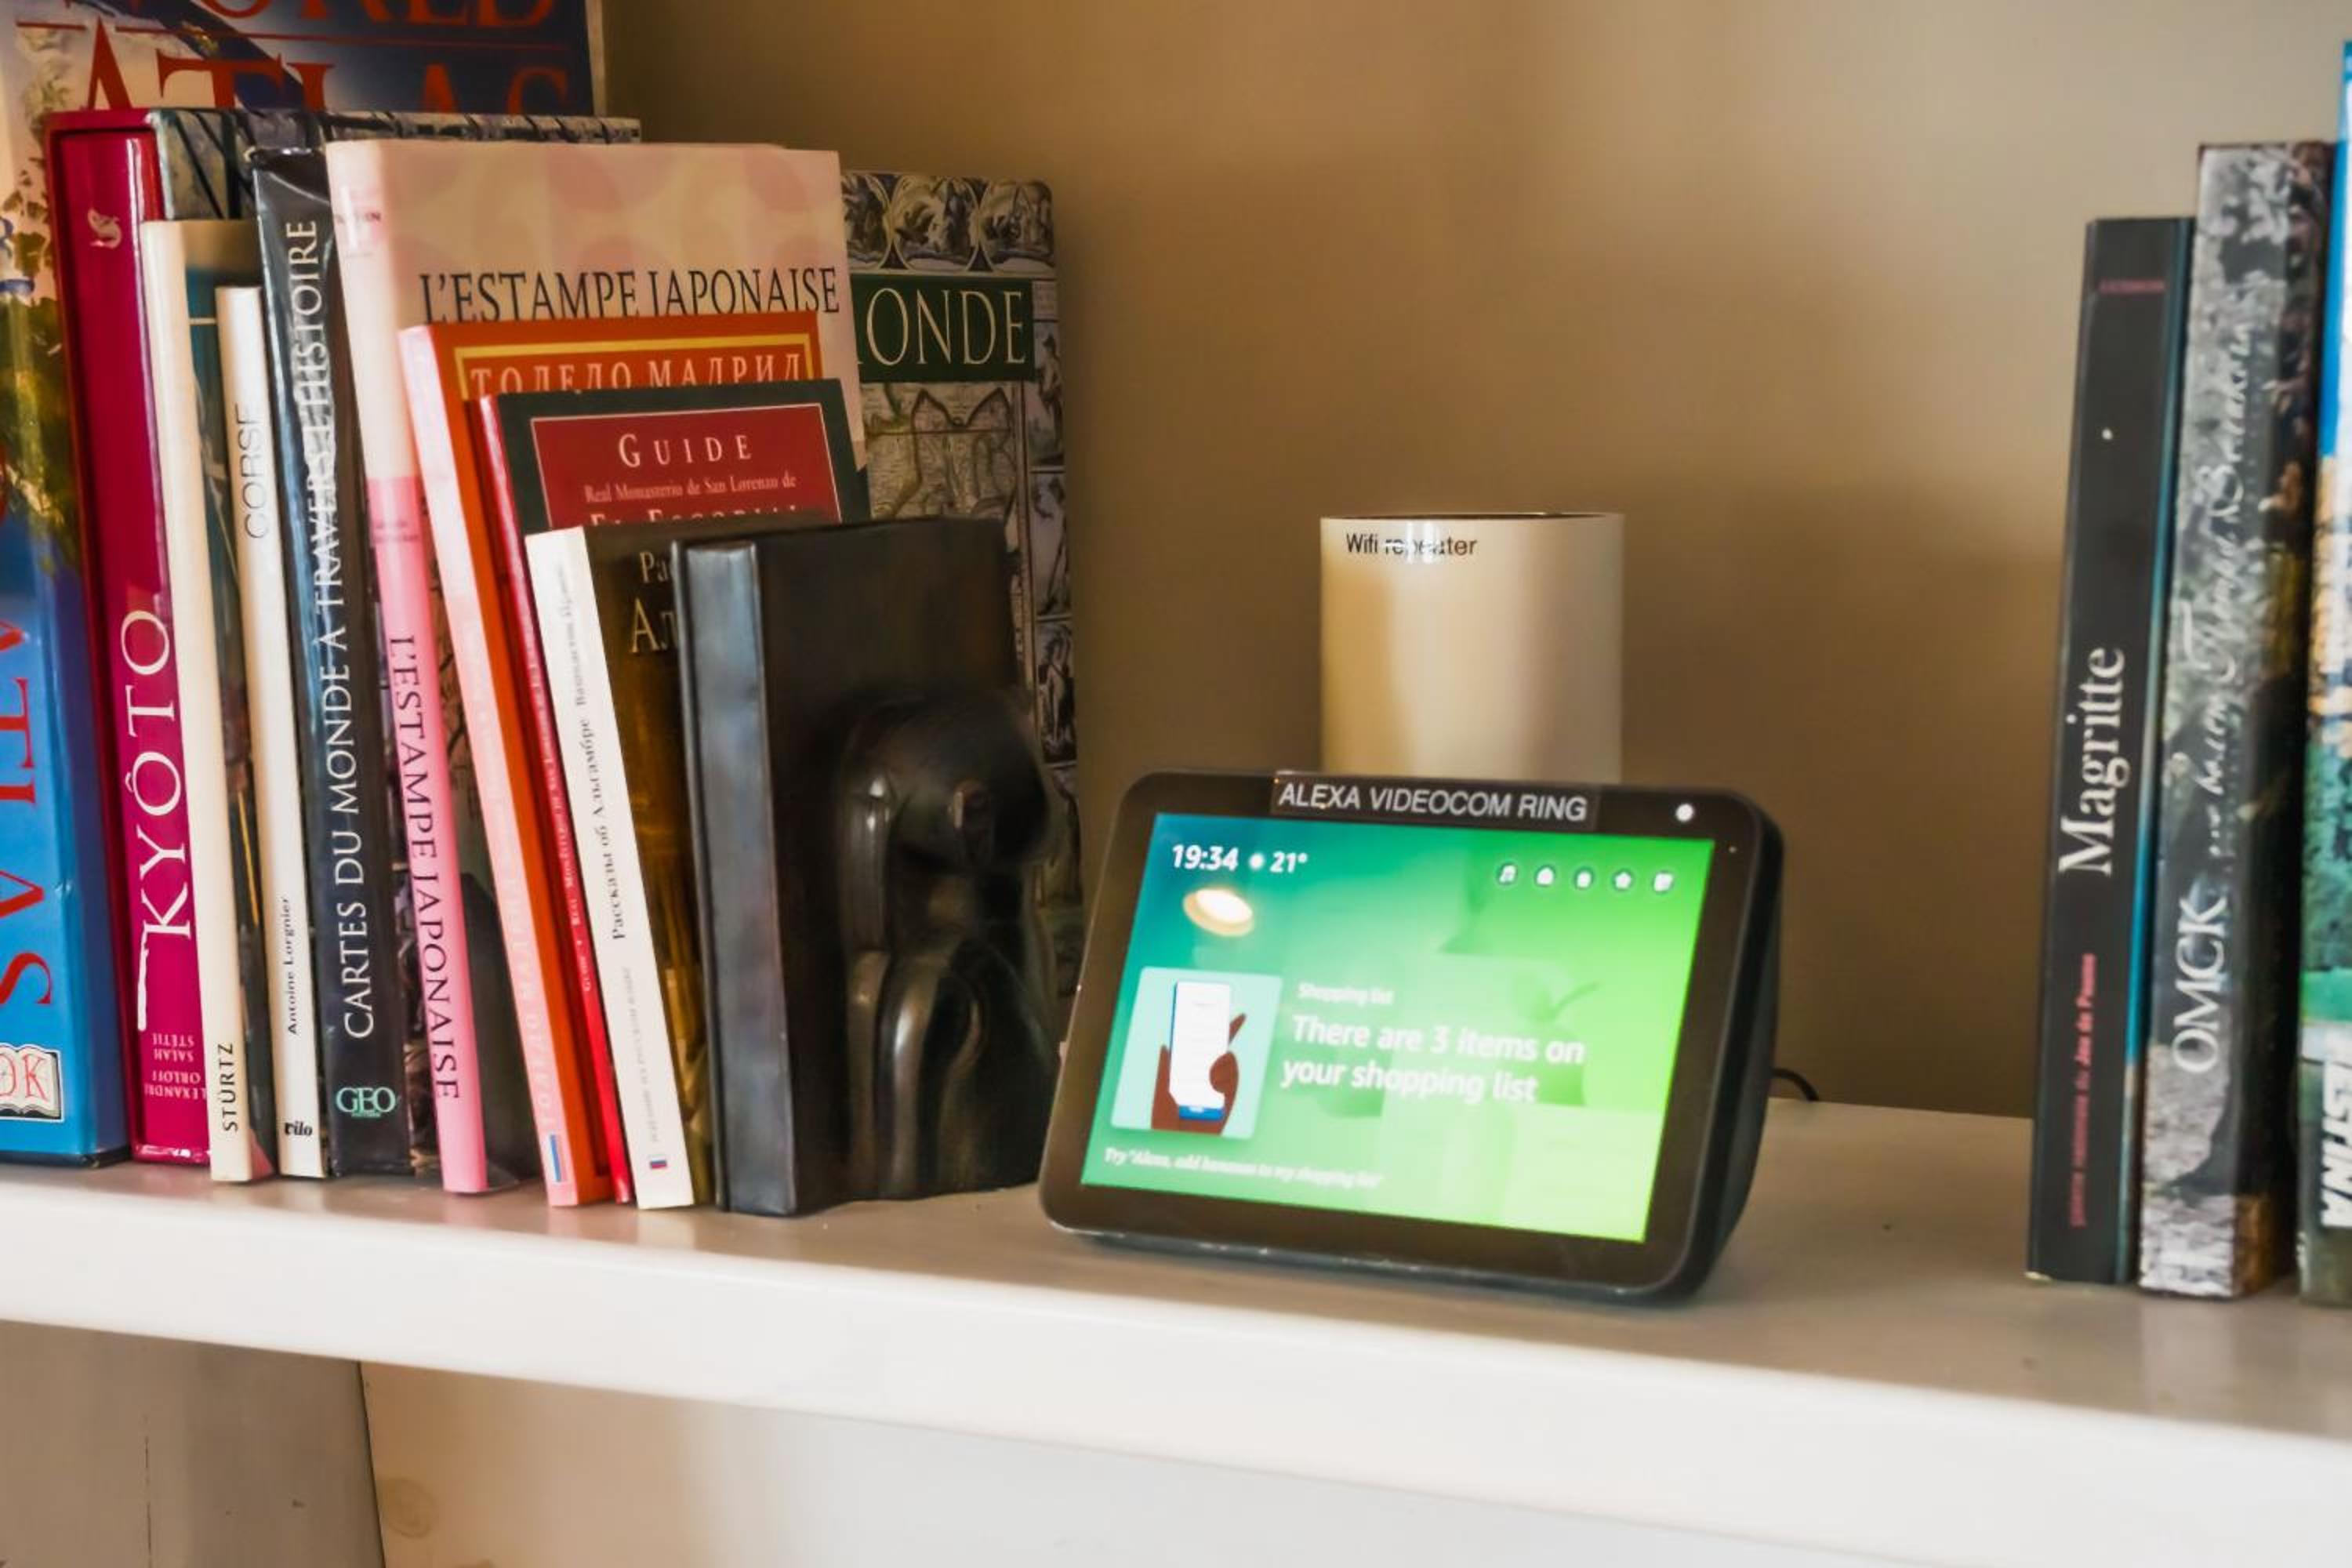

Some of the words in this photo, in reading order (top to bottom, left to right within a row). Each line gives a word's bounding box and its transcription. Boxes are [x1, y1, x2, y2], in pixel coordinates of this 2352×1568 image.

[419, 269, 637, 325] L'ESTAMPE
[648, 265, 840, 318] JAPONAISE
[858, 287, 1025, 366] ONDE
[236, 403, 270, 539] CORSE
[584, 483, 612, 504] Real
[615, 481, 684, 502] Monasterio
[686, 477, 701, 496] de
[703, 477, 727, 495] San
[729, 474, 779, 493] Lorenzo
[782, 471, 797, 489] de
[1345, 532, 1378, 554] Wifi
[320, 663, 361, 820] MONDE
[390, 634, 437, 860] L'ESTAMPE
[2057, 646, 2132, 877] Magritte
[120, 609, 192, 940] KYÔTO
[1279, 782, 1361, 810] ALEXA
[1370, 787, 1512, 817] VIDEOCOM
[1518, 793, 1588, 822] RING
[332, 831, 364, 891] DU
[595, 825, 612, 848] об
[1172, 844, 1240, 872] 19:34
[1269, 850, 1308, 873] 21°
[602, 851, 627, 940] Рассказы
[281, 898, 297, 965] Lorgnier
[338, 903, 374, 1040] CARTES
[412, 872, 459, 1099] JAPONAISE
[1298, 982, 1368, 1006] Shopping
[285, 971, 299, 1036] Antoine
[1291, 1014, 1370, 1048] There
[1377, 1028, 1424, 1052] are
[1430, 1024, 1450, 1054] 3
[1457, 1028, 1538, 1062] items
[1545, 1040, 1585, 1065] on
[335, 1085, 397, 1112] GEO
[1279, 1059, 1347, 1089] your
[1351, 1061, 1484, 1105] shopping
[1493, 1070, 1538, 1103] list
